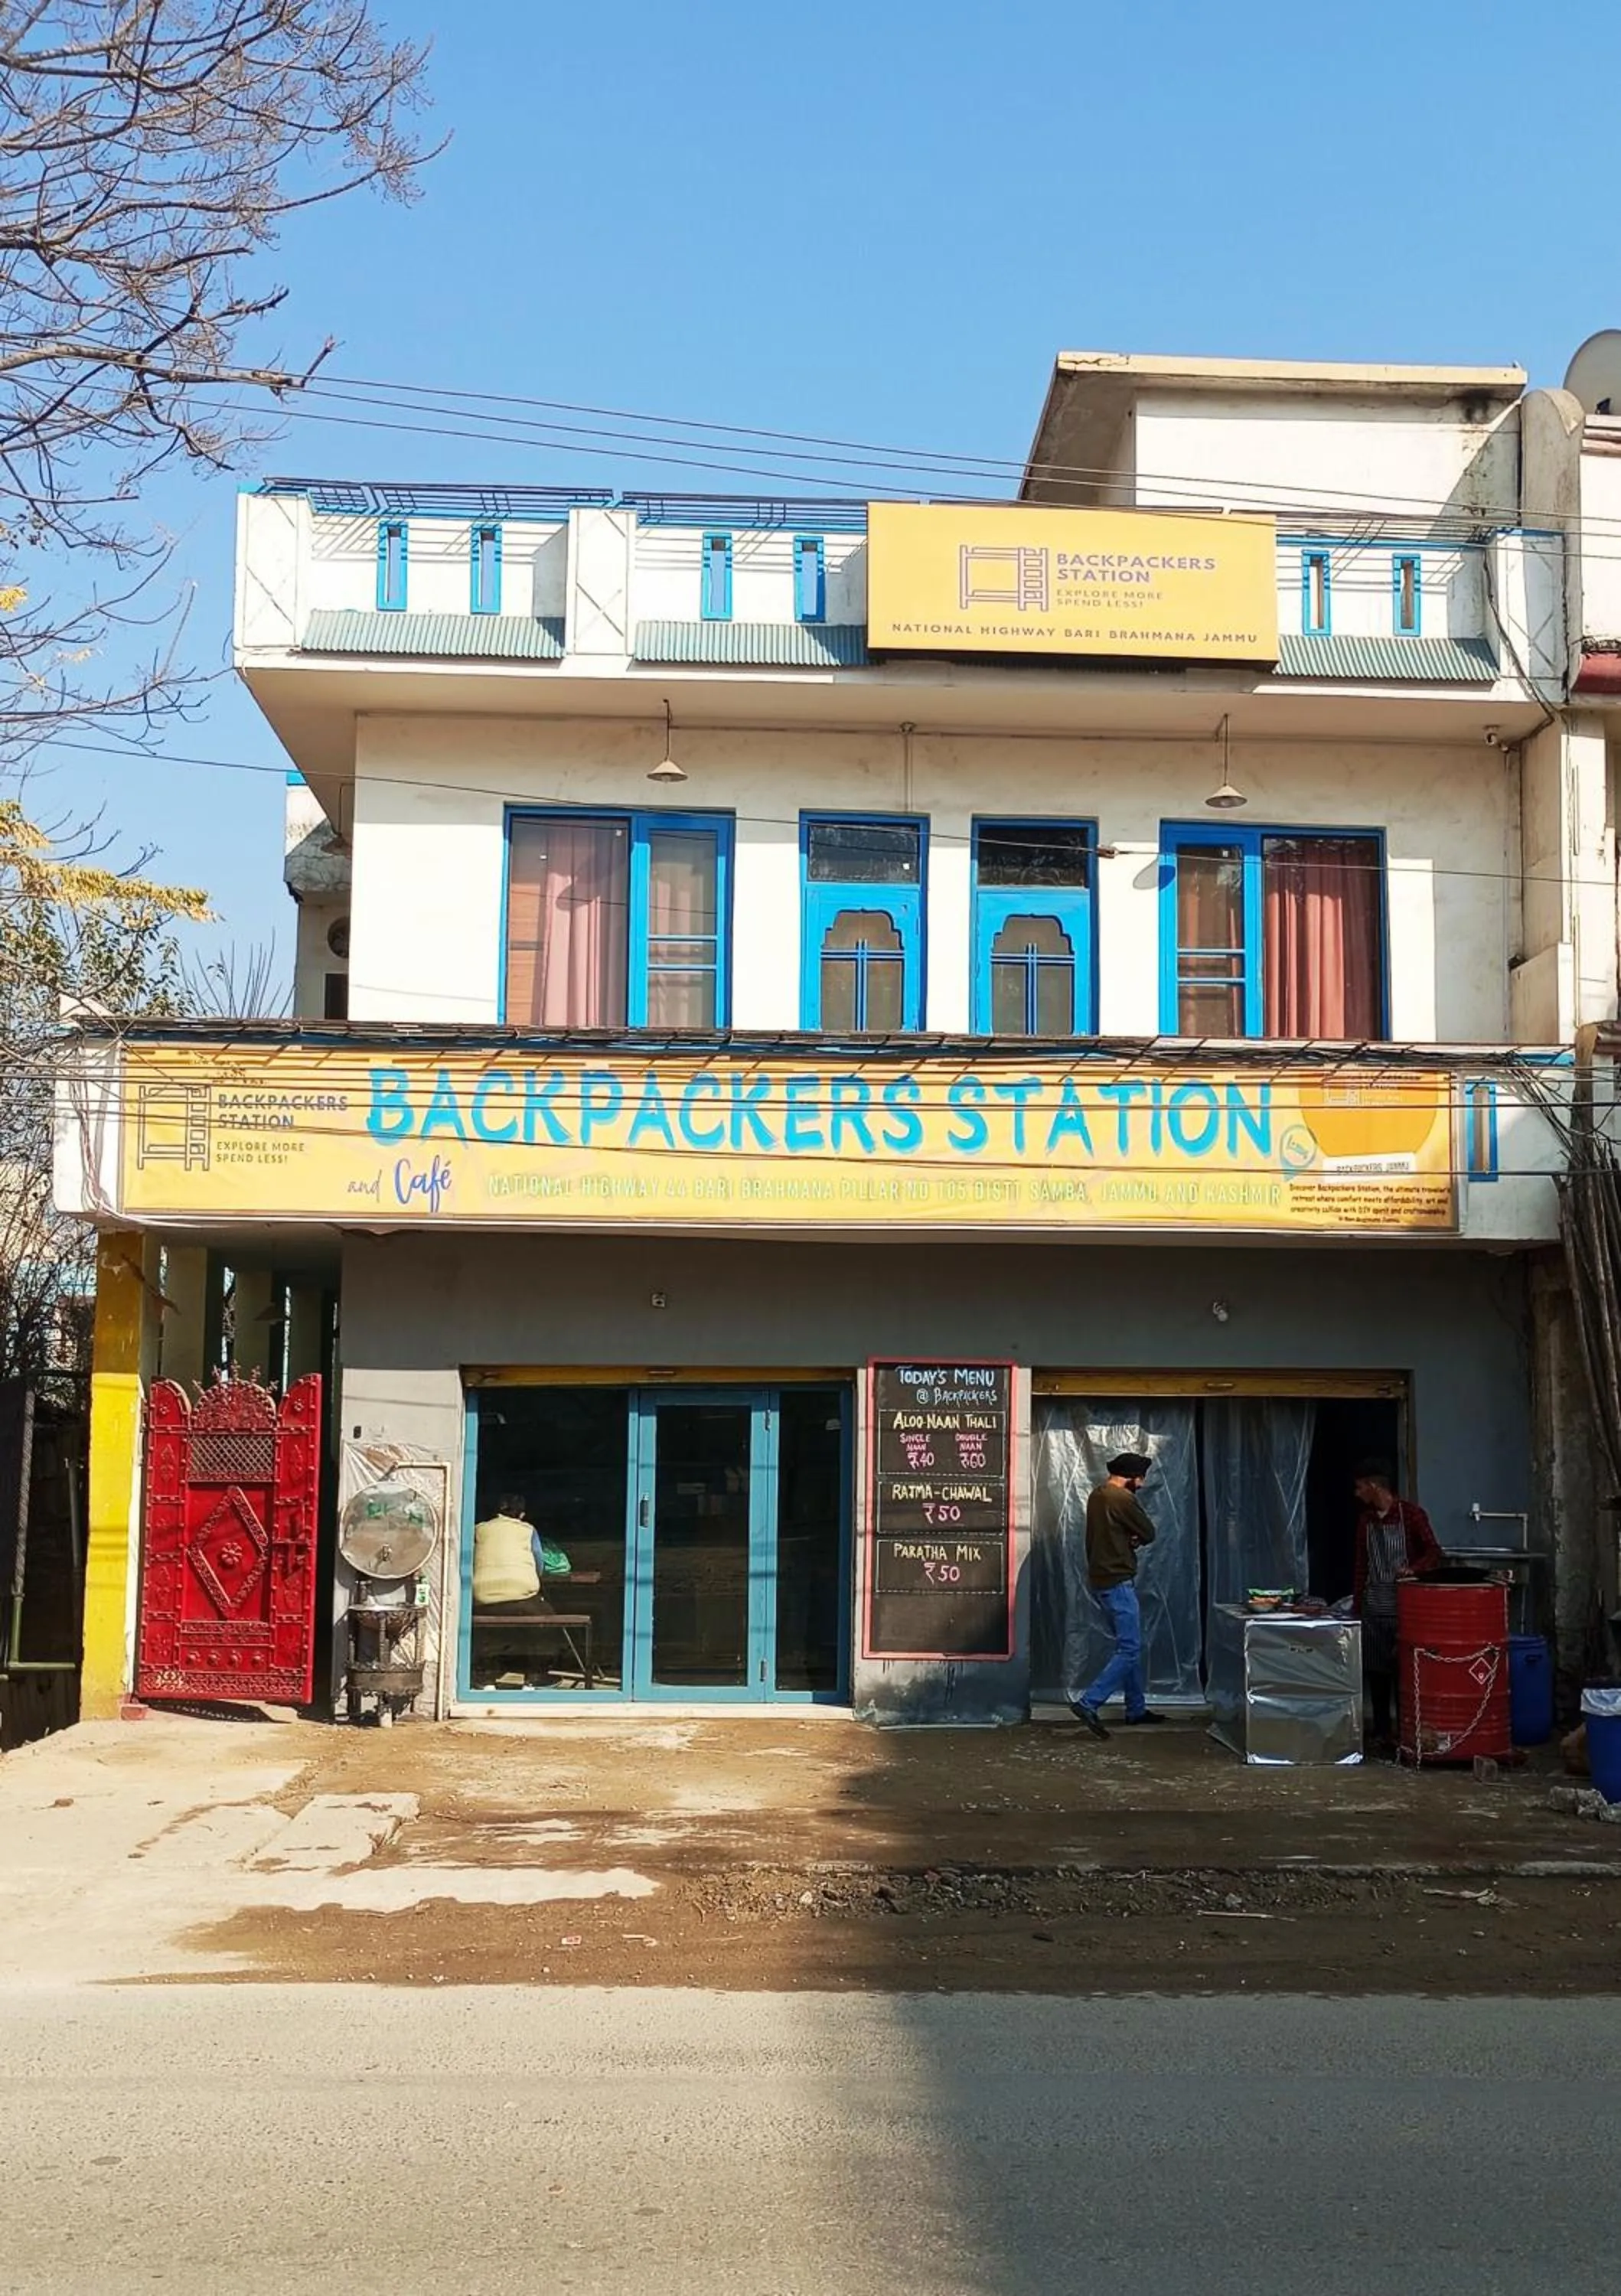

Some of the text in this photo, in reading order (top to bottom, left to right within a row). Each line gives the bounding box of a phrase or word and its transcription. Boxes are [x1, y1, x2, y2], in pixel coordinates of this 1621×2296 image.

[1057, 553, 1215, 570] BACKPACKERS
[1057, 569, 1150, 582] STATION
[1057, 589, 1163, 600] EXPLORE MORE
[1057, 598, 1143, 608] SPEND LESS!
[892, 624, 1257, 643] NATIONAL HIGHWAY BARI BRAHMANA JAMMU
[218, 1094, 348, 1111] BACKPACKERS
[366, 1066, 1271, 1157] BACKPACKERS STATION
[217, 1114, 294, 1129] STATION
[217, 1141, 305, 1152] EXPLORE MORE
[216, 1153, 288, 1163] SPEND LESS!
[347, 1154, 452, 1213] and Café
[489, 1174, 571, 1198] NATIONAL
[581, 1176, 659, 1199] HIGHWAY
[667, 1178, 687, 1198] 44
[694, 1178, 733, 1200] BARI
[742, 1178, 833, 1200] BRAHMANA
[841, 1178, 899, 1201] PILLAR
[907, 1180, 928, 1200] NO
[938, 1180, 966, 1200] 105
[1101, 1182, 1157, 1202] JAMMU
[1166, 1182, 1199, 1203] AND
[1207, 1183, 1281, 1205] KASHMIR
[895, 1365, 994, 1387] TODAY'S MENU
[916, 1388, 929, 1404] @
[965, 1414, 997, 1429] THALI
[900, 1433, 931, 1443] SINGLE
[960, 1443, 982, 1451] NAAN
[894, 1543, 981, 1562] PARATHA MIX
